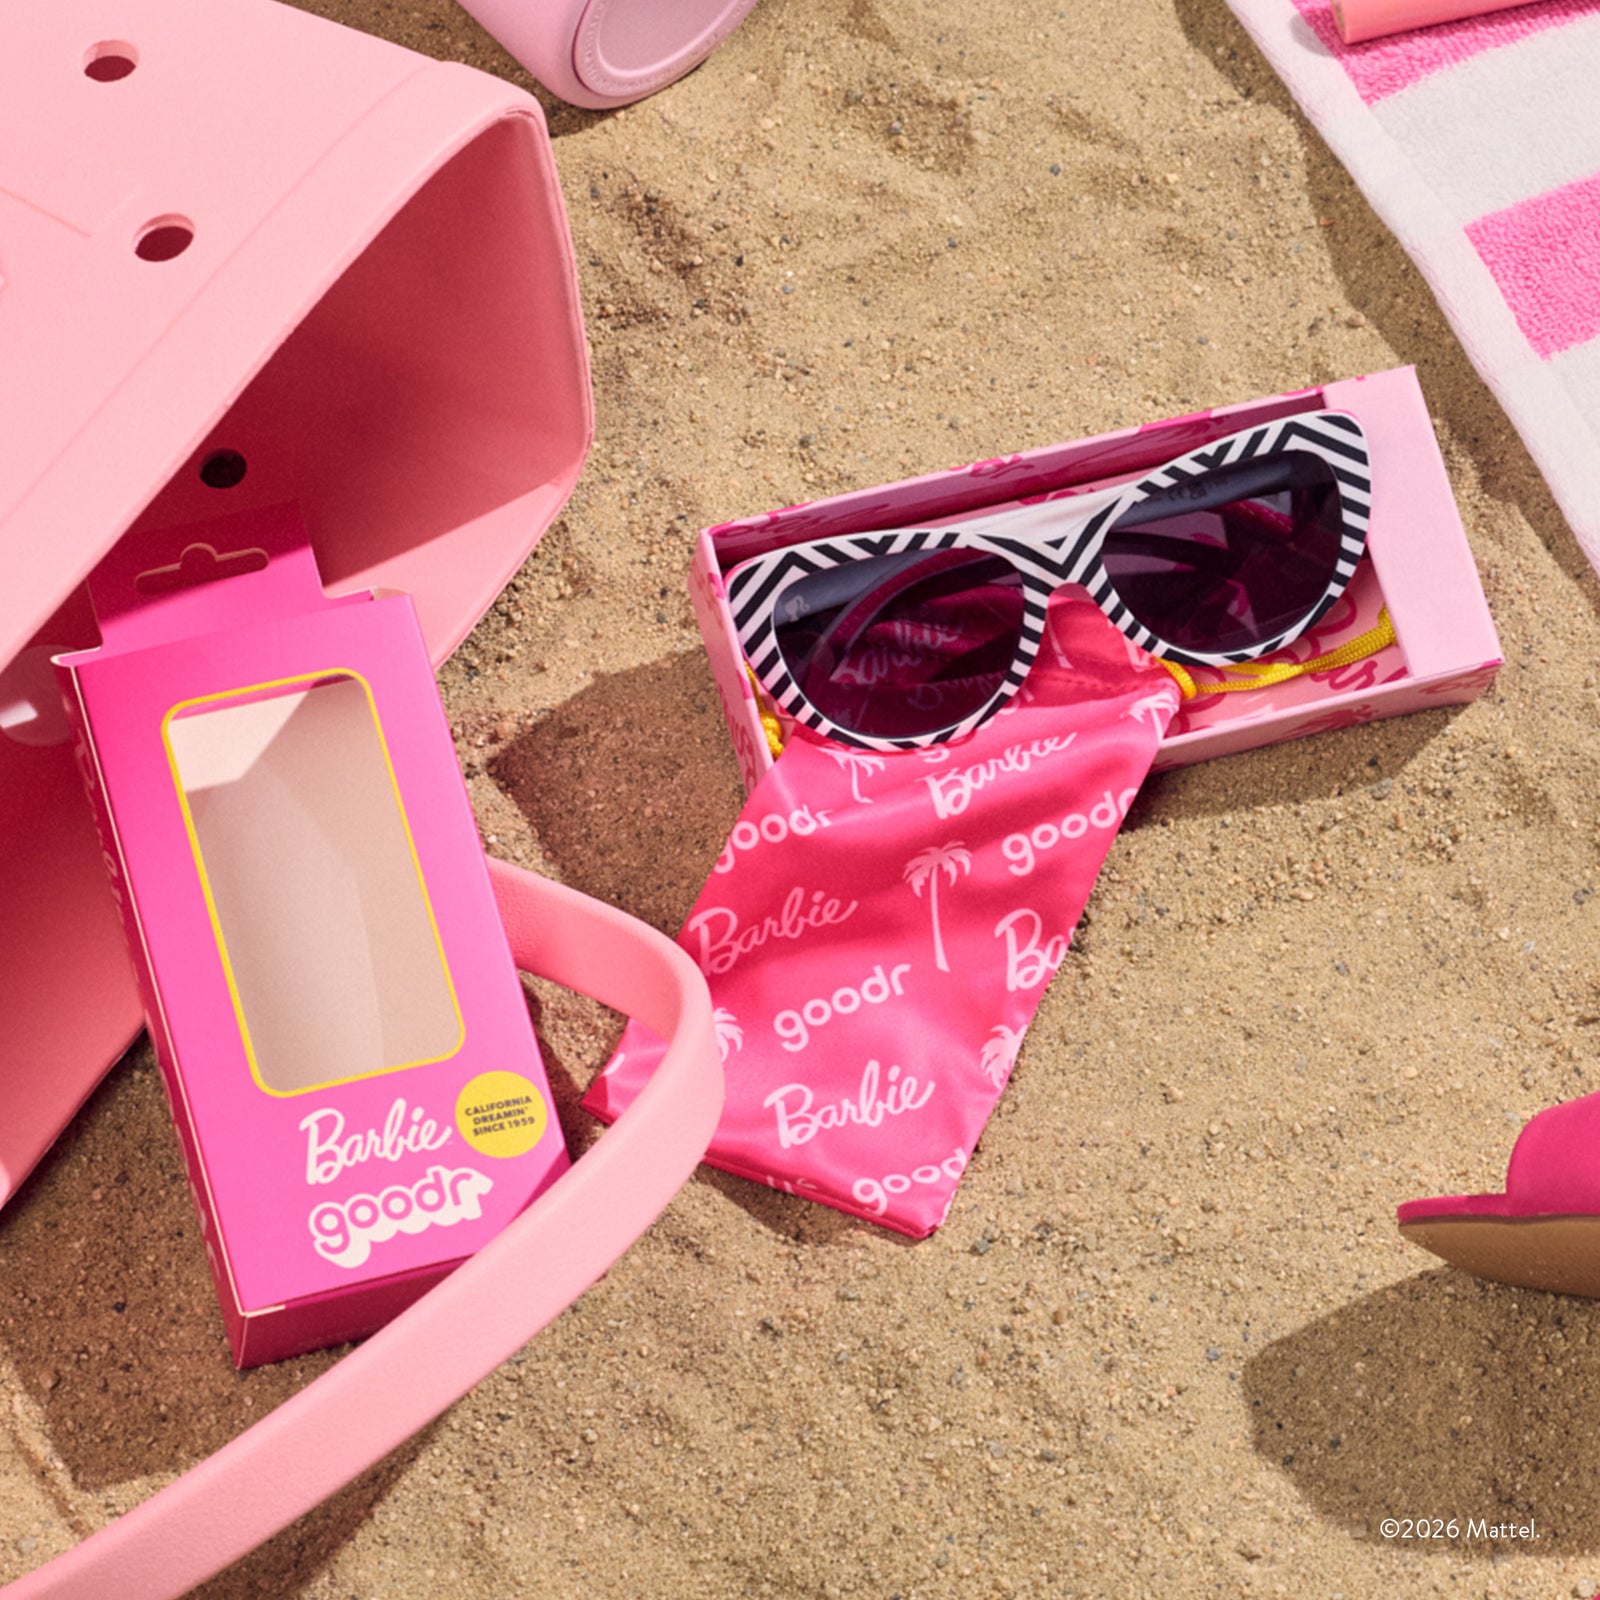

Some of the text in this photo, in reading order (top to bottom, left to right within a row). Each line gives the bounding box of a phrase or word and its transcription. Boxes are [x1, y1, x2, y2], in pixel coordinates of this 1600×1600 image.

[914, 732, 1077, 819] Barbie
[688, 886, 859, 977] Barbie
[994, 908, 1076, 992] Ba
[773, 964, 912, 1053] goodr
[299, 1097, 452, 1185] Barbie
[464, 1095, 532, 1116] CALIFORNIA
[472, 1116, 535, 1137] SINCE 1959
[763, 1059, 936, 1149] Barbie
[311, 1167, 484, 1260] goodr
